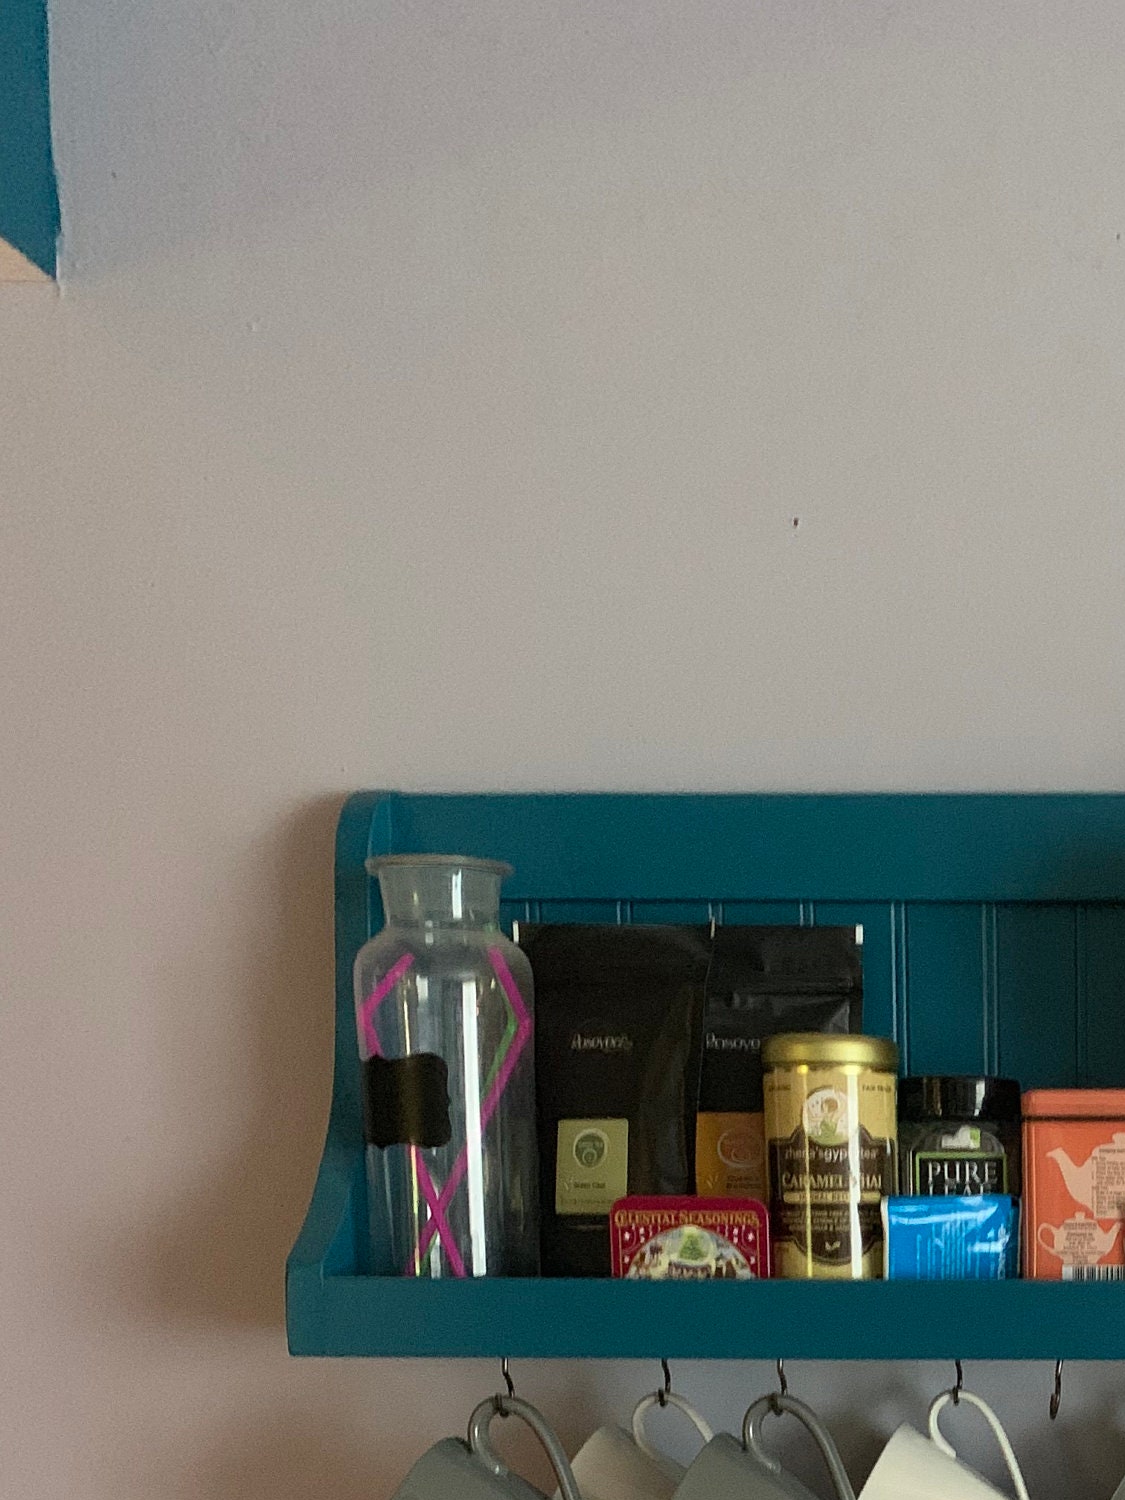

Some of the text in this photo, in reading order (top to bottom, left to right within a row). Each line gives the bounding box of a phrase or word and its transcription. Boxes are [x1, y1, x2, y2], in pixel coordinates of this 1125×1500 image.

[927, 1160, 998, 1184] PURE
[614, 1209, 760, 1227] CELESTIAL SEASONINGS
